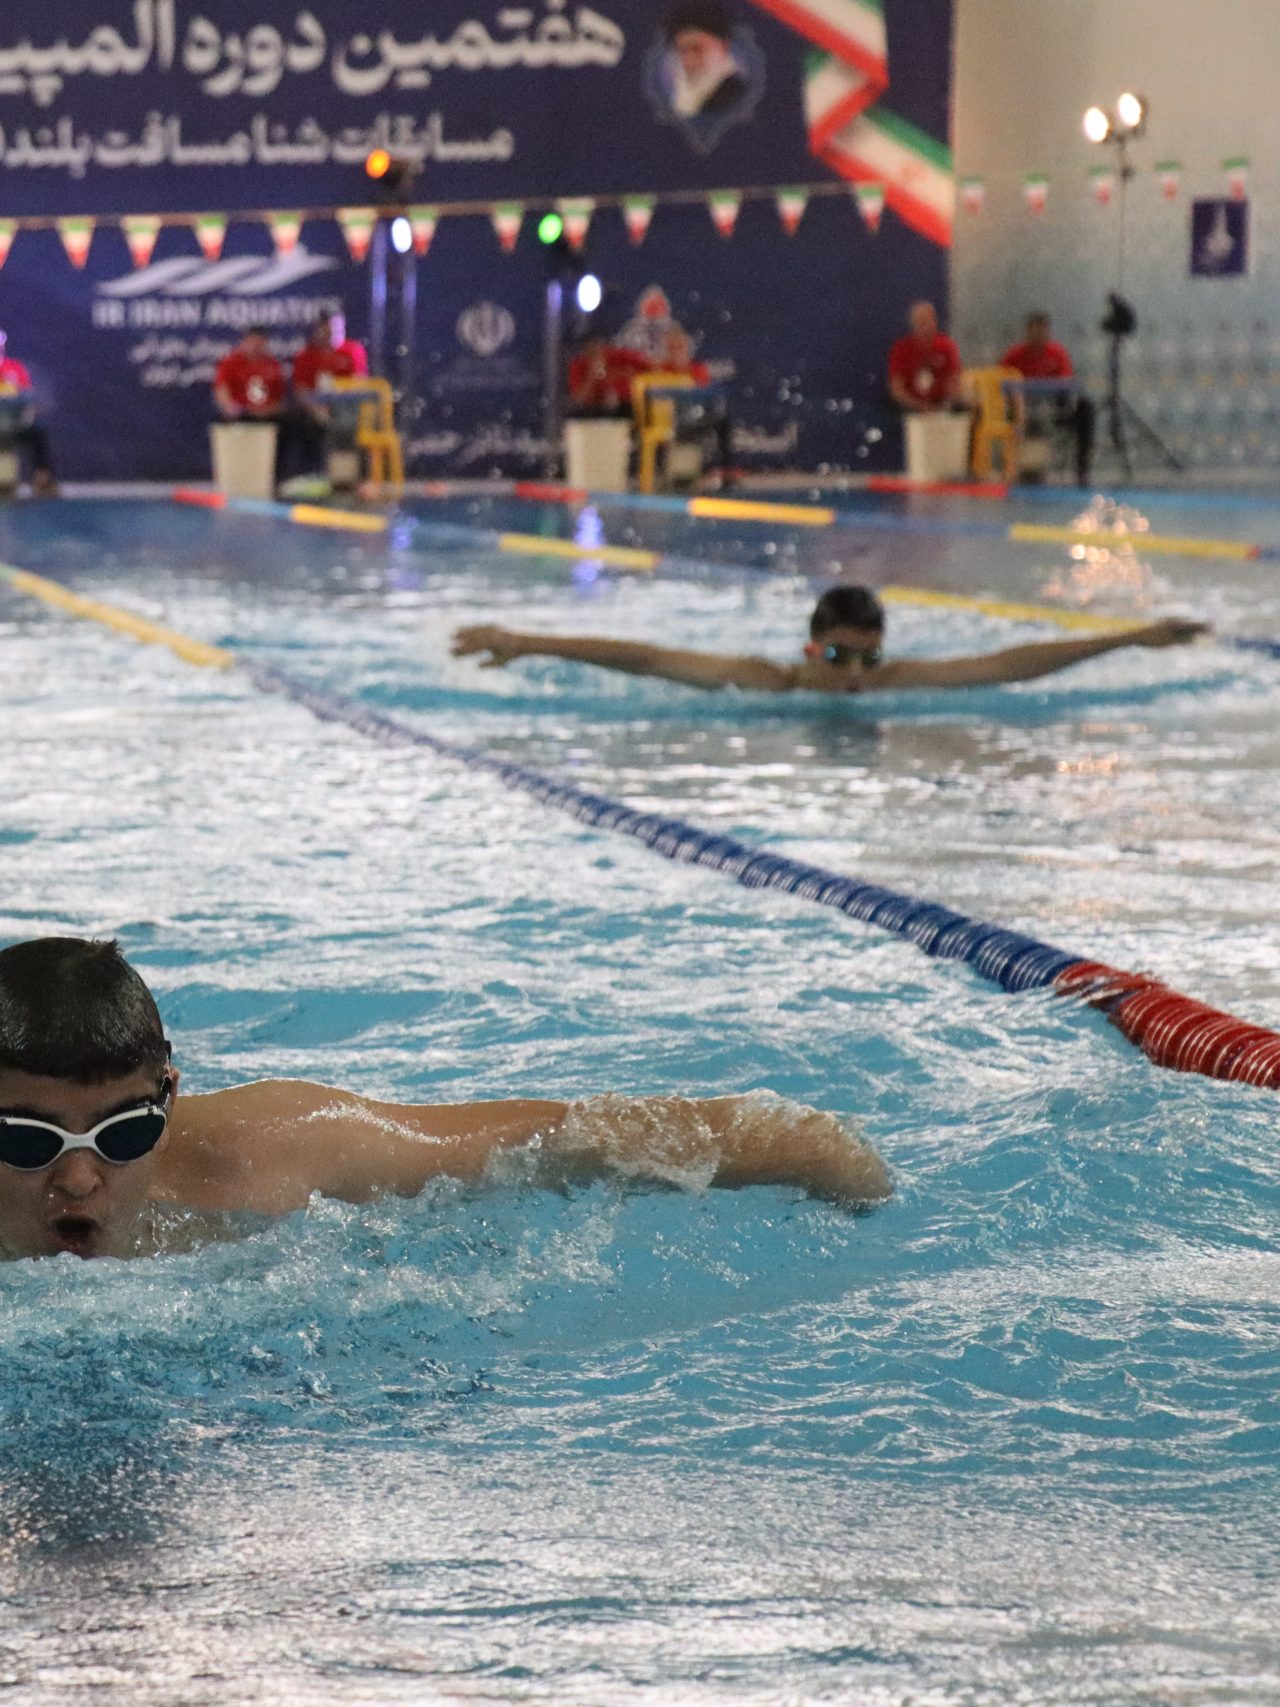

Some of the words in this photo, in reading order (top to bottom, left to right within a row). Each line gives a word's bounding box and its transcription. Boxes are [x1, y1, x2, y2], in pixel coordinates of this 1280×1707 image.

[183, 12, 327, 96] دوره
[331, 0, 626, 96] هفتمین
[95, 110, 251, 168] مسافت
[252, 112, 330, 164] شنا
[331, 111, 515, 174] مسابقات
